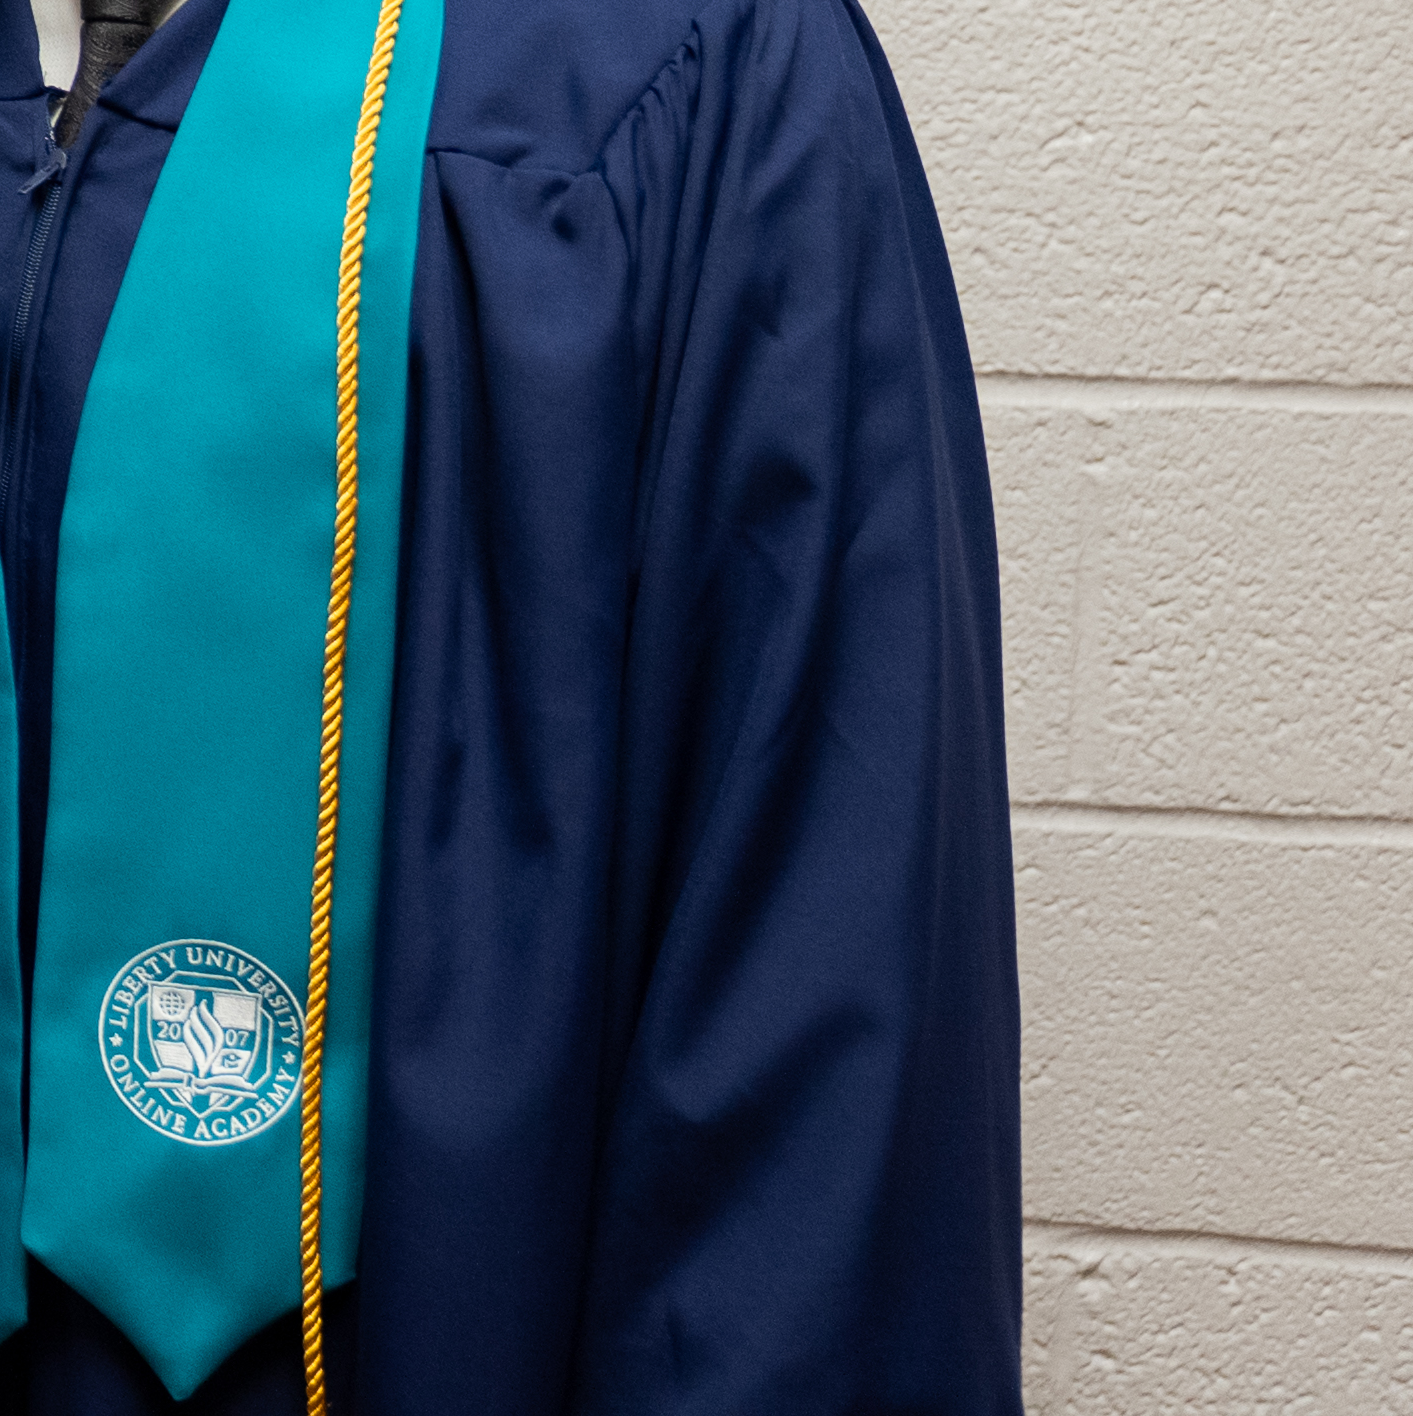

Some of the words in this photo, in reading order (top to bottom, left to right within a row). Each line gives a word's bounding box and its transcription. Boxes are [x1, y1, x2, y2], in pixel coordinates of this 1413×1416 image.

[109, 948, 176, 1031] LIBERTY
[185, 946, 300, 1048] UNIVERSITY
[109, 1054, 186, 1134] ONLINE
[194, 1068, 295, 1140] ACADEMY
